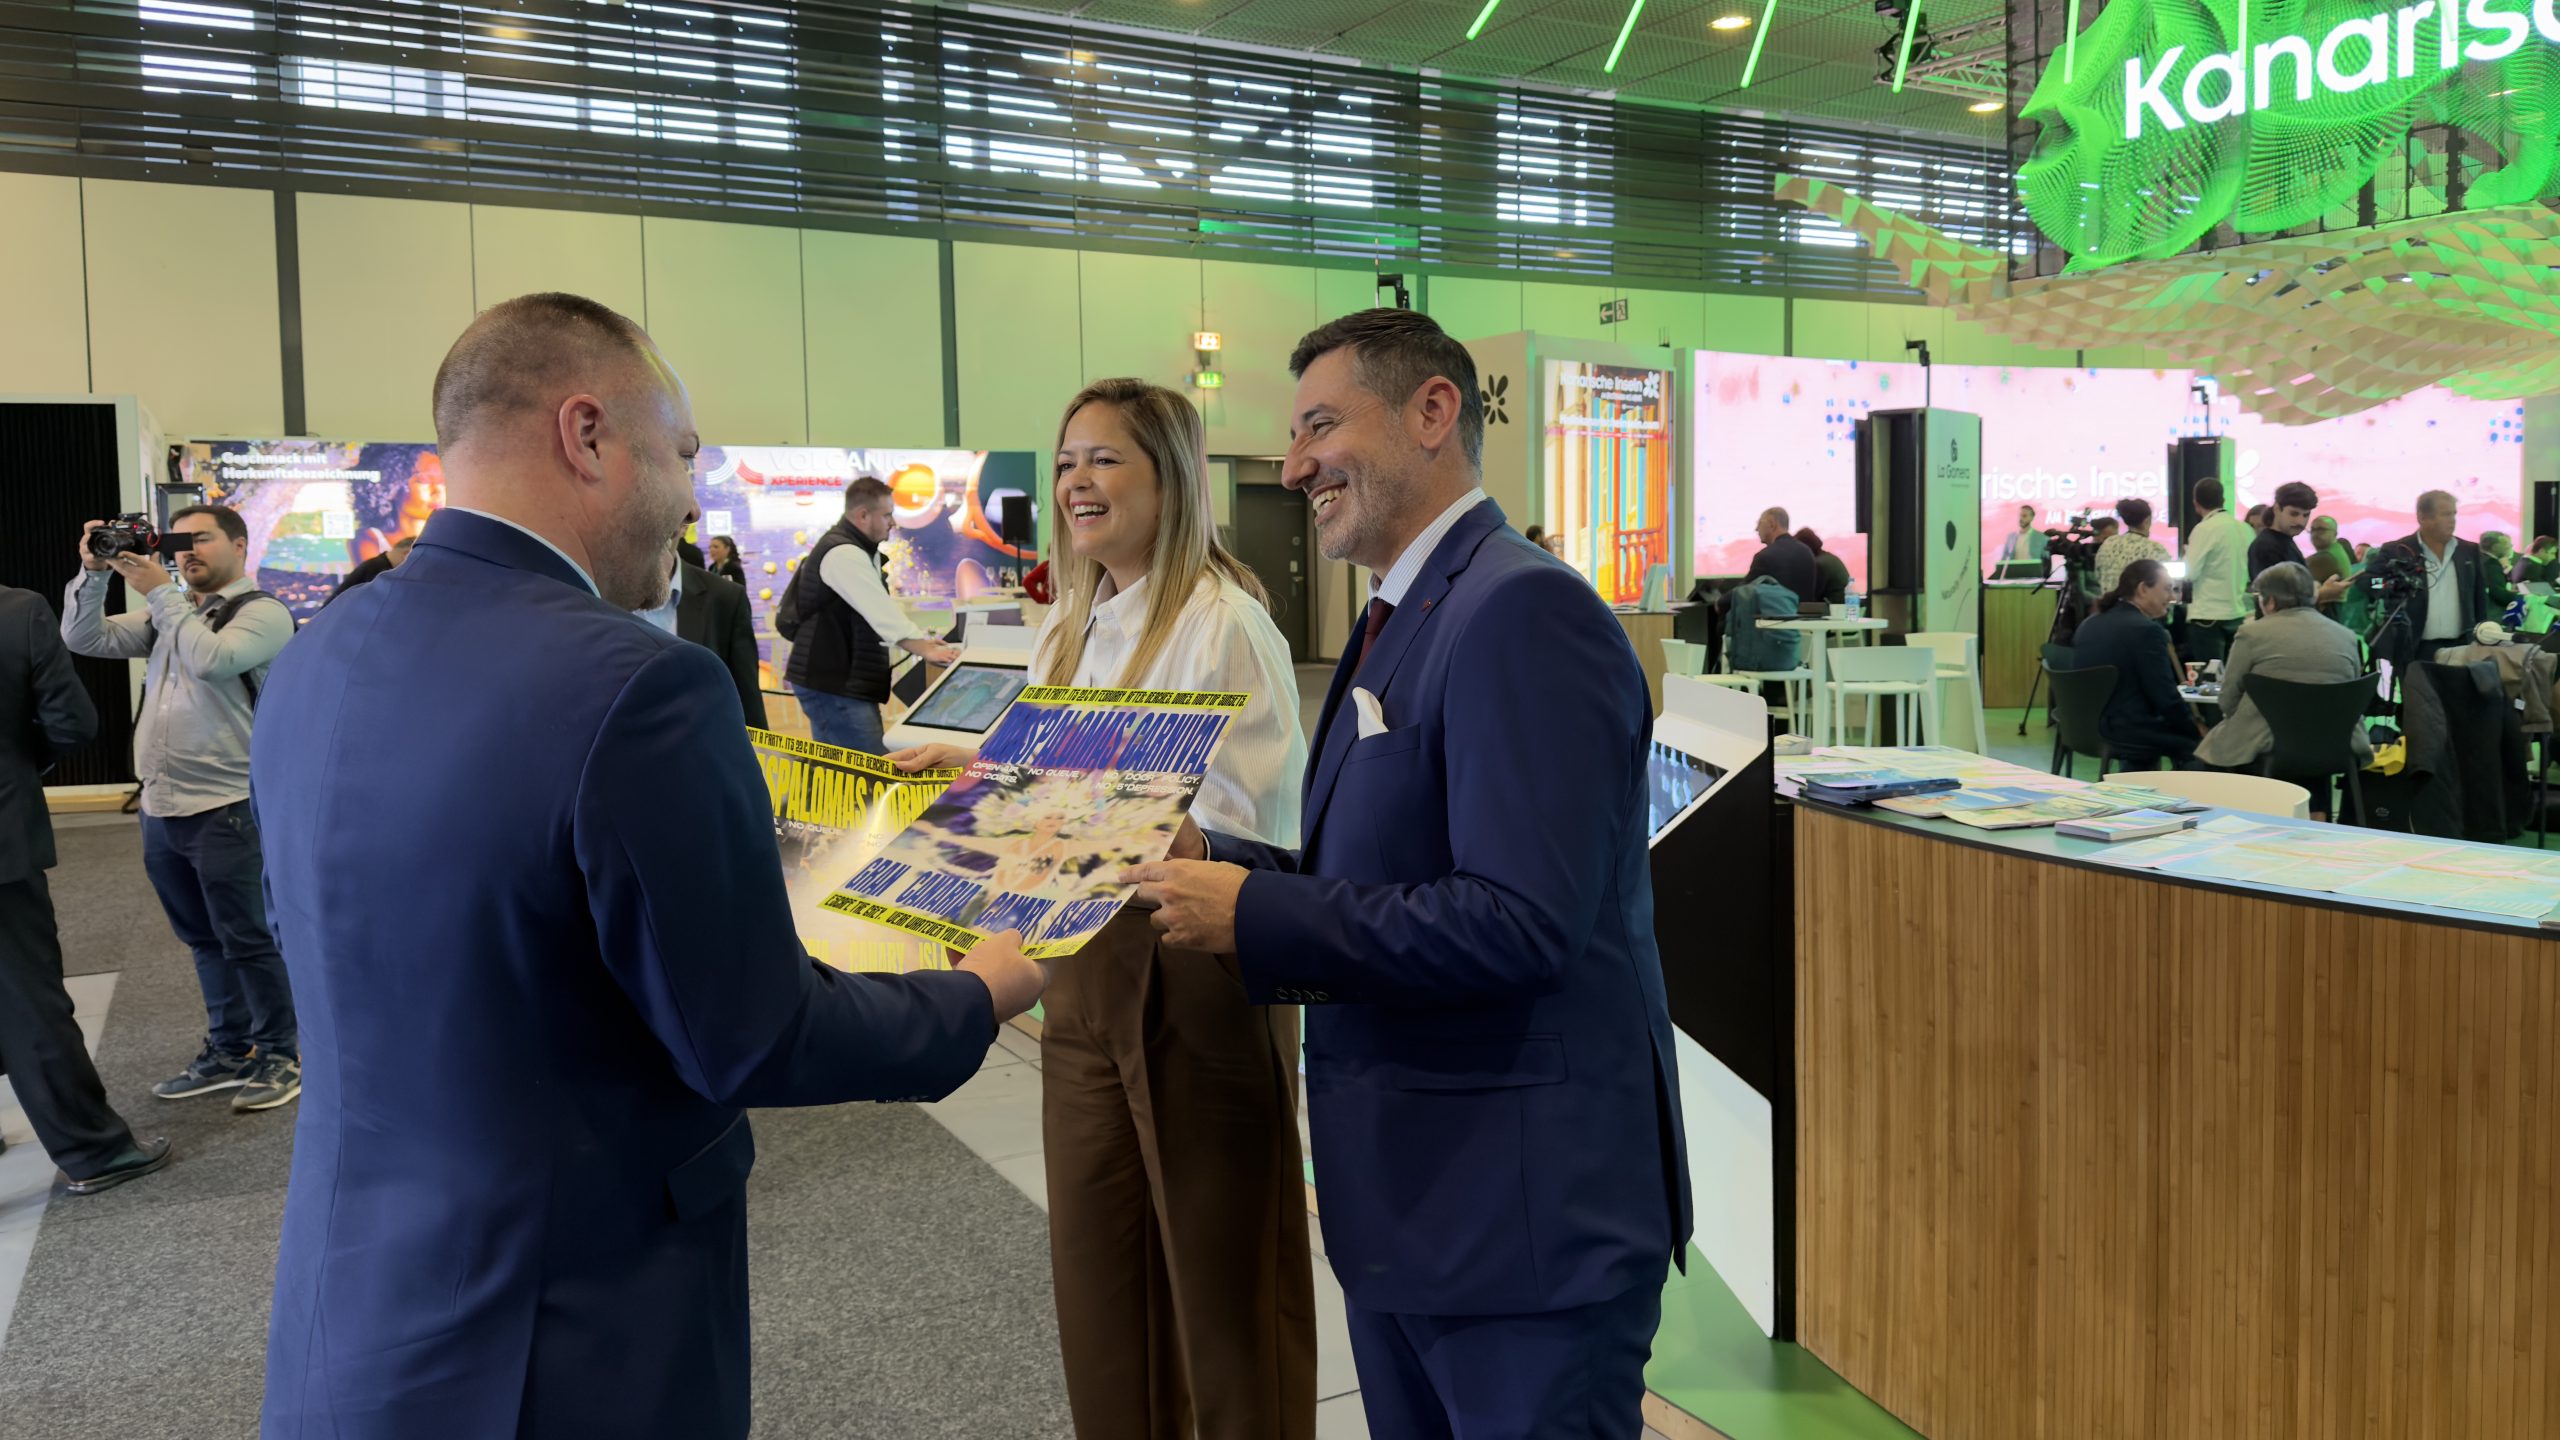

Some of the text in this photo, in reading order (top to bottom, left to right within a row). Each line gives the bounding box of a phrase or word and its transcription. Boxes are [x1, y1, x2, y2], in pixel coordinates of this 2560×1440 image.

[221, 452, 328, 465] Geschmack mit
[222, 467, 381, 483] Herkunftsbezeichnung
[1982, 464, 2168, 500] rische Insel
[1116, 711, 1231, 775] CARNIVAL
[815, 744, 844, 763] FEBRUARY
[973, 761, 1001, 772] OPEN
[1027, 768, 1044, 776] NO
[965, 770, 982, 778] NO
[1125, 773, 1156, 781] DOOR
[757, 753, 950, 832] SPALOMAS CARNI
[788, 821, 805, 830] NO
[844, 857, 1123, 940] GRAN CANARIA CANARY ISLANDS
